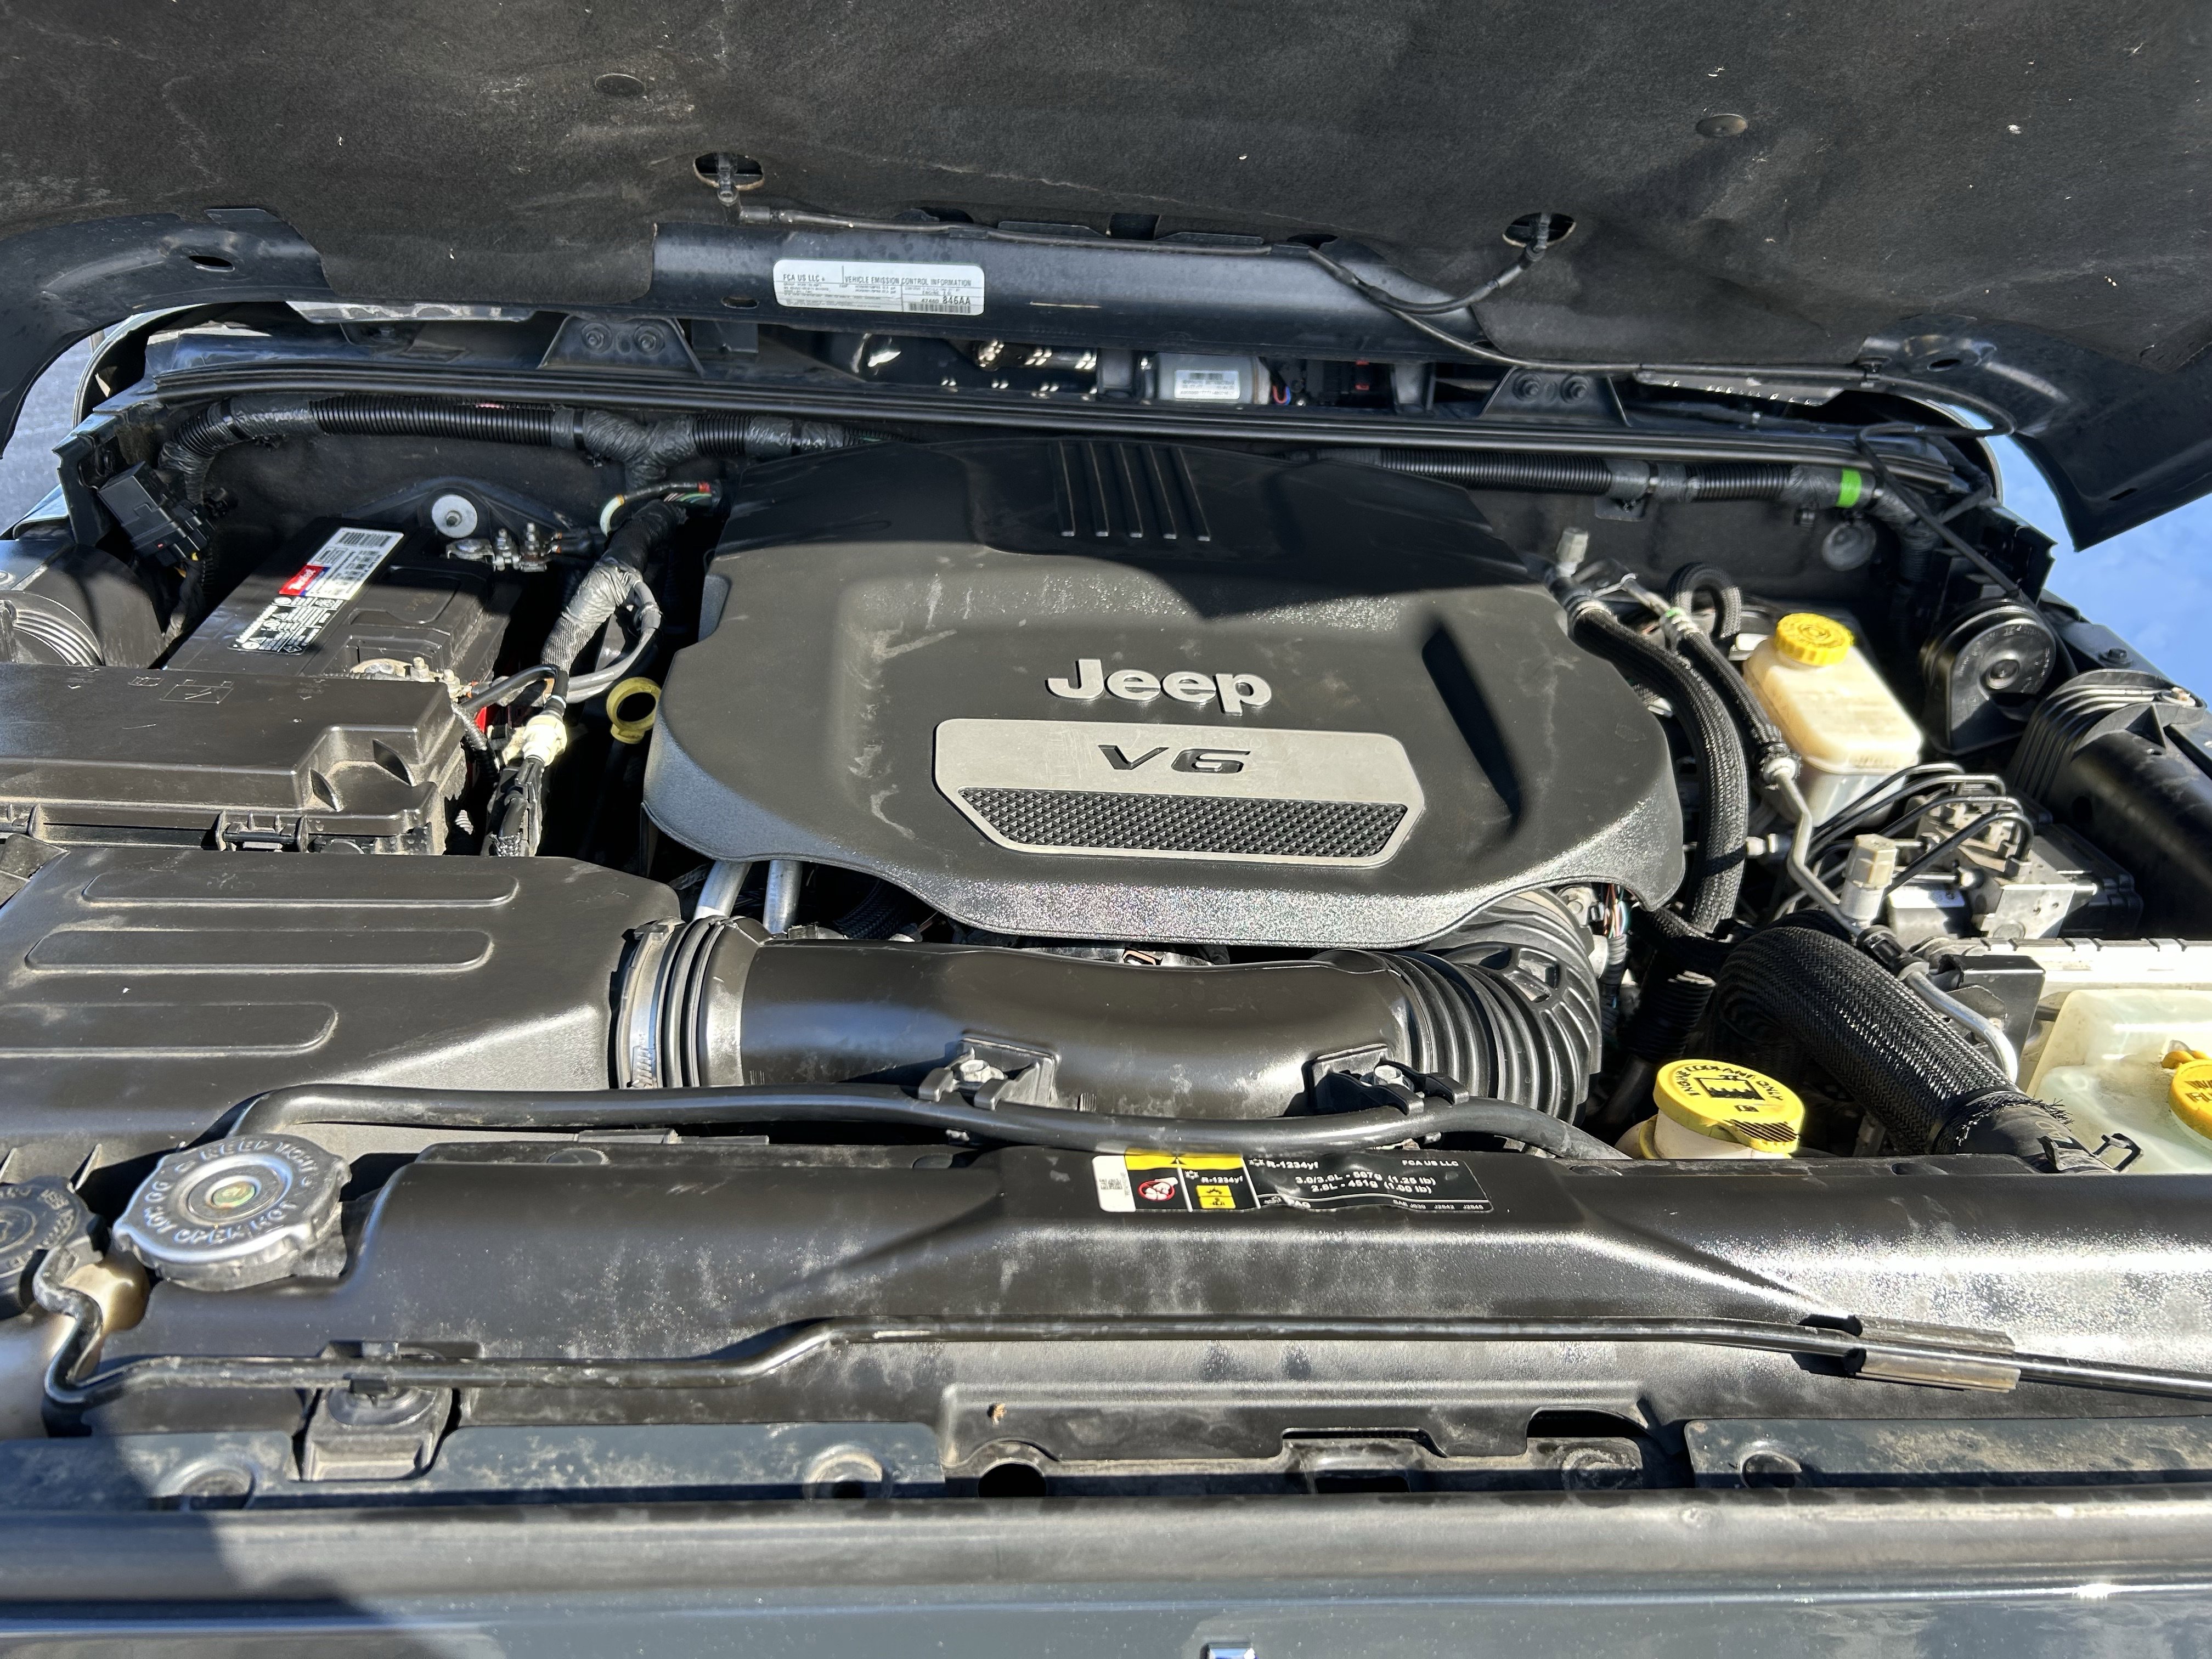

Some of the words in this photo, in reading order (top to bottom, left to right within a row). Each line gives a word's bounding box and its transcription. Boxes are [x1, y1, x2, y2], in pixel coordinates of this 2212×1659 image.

[783, 273, 795, 281] FCA
[798, 274, 806, 282] US
[871, 276, 899, 285] EMISSION
[901, 278, 928, 286] CONTROL
[930, 279, 972, 287] INFORMATION
[942, 296, 971, 305] 846AA
[1045, 658, 1272, 716] Jeep
[1097, 744, 1251, 774] V6
[1684, 1064, 1757, 1081] COOLANT
[1755, 1080, 1784, 1101] ONLY
[198, 1139, 272, 1161] KEEP
[1266, 1161, 1319, 1170] R-1234yf
[1387, 1175, 1417, 1184] (1.25
[1418, 1177, 1437, 1186] lb)
[1384, 1181, 1413, 1193] (1.00
[1414, 1185, 1432, 1194] lb)
[144, 1205, 178, 1234] NOT
[173, 1223, 245, 1245] OPEN
[250, 1200, 298, 1232] HOT
